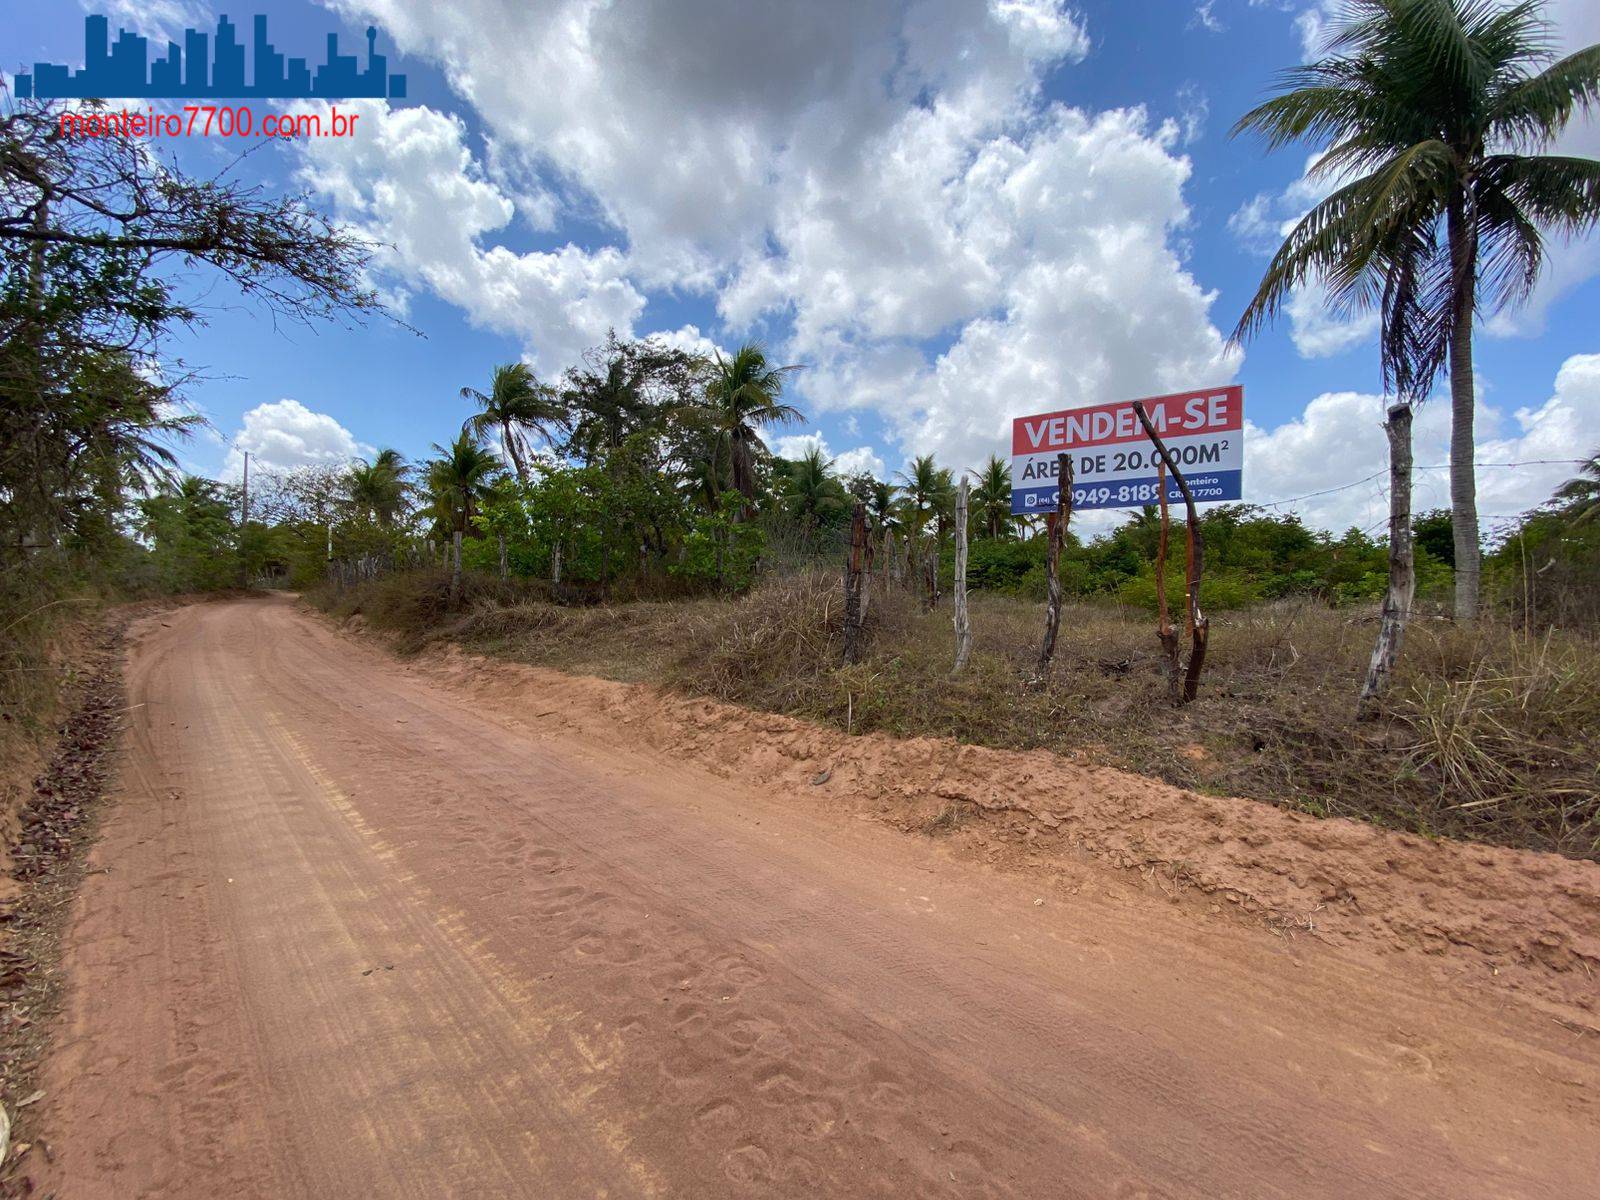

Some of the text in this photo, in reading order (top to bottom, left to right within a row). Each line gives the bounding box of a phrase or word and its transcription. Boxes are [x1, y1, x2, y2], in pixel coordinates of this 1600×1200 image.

[1024, 394, 1228, 449] VENDEM-SE
[1081, 455, 1106, 474] DE
[1175, 476, 1219, 487] onteiro
[1197, 487, 1223, 497] 7700
